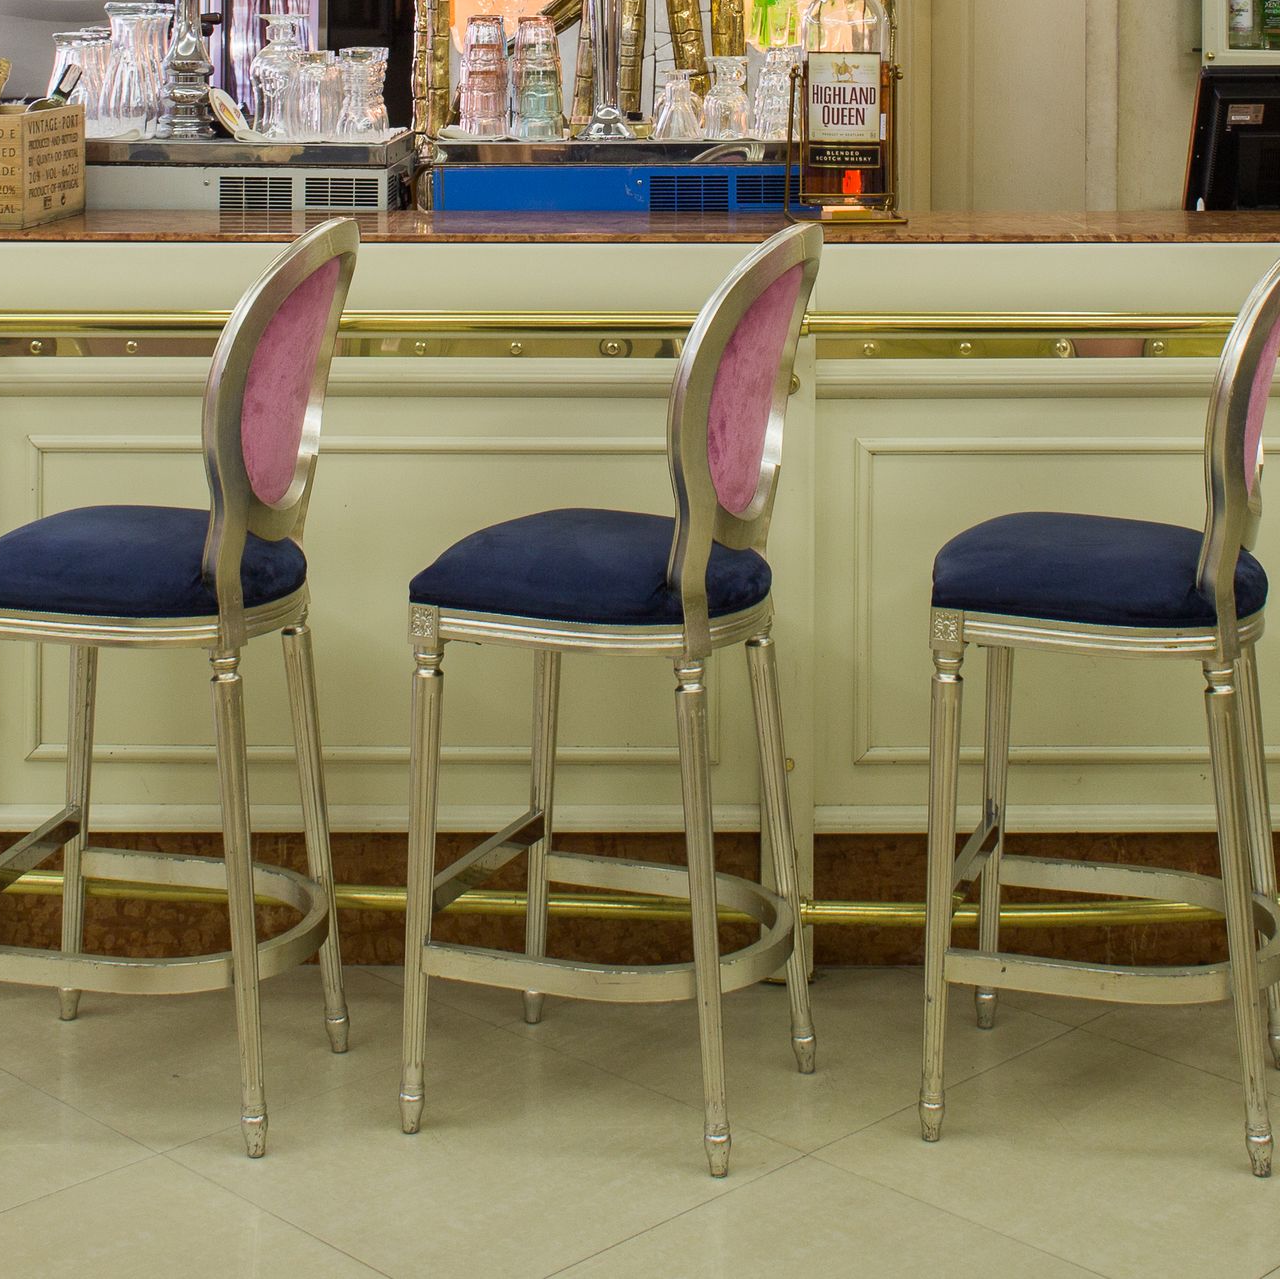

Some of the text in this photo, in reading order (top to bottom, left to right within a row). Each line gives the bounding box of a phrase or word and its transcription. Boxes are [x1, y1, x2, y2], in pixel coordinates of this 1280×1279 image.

[812, 84, 876, 105] HIGHLAND
[28, 114, 79, 134] VINTAGE PORT
[822, 105, 865, 128] QUEEN
[10, 129, 16, 139] E
